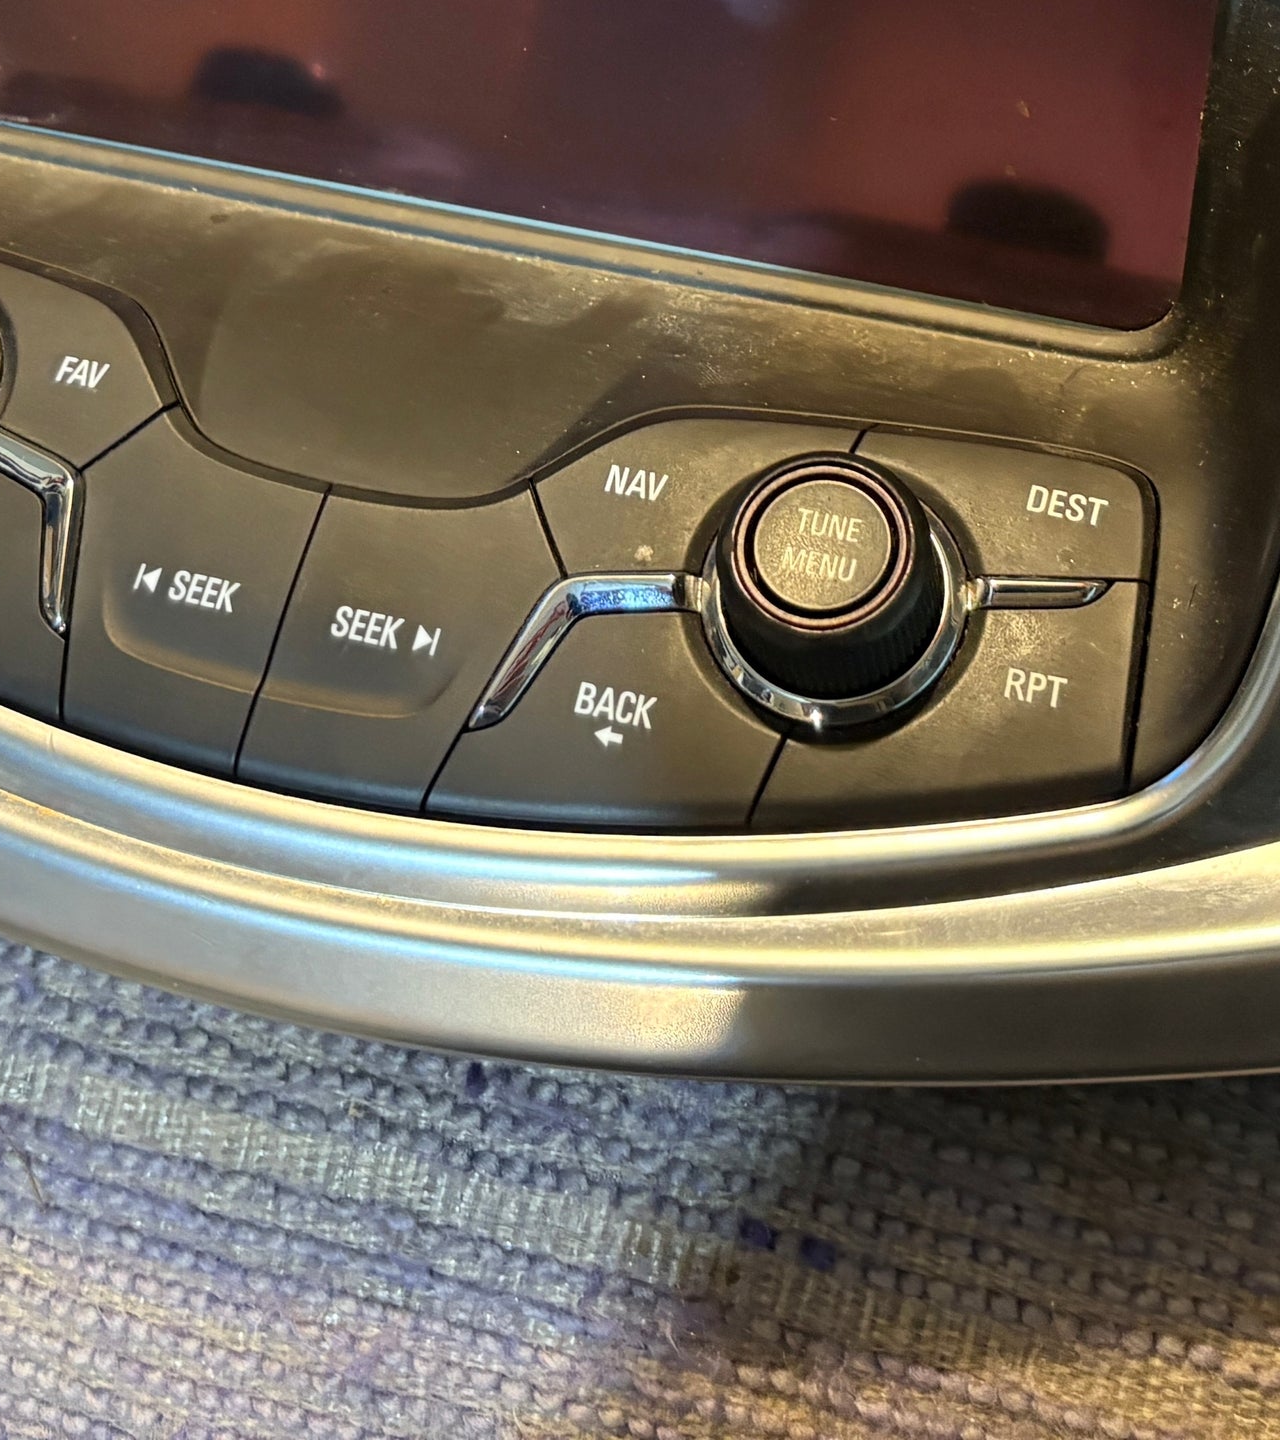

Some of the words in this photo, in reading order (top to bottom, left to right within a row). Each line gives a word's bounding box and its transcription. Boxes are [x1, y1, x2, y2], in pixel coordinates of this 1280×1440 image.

[55, 355, 111, 390] FAV
[604, 464, 669, 502] NAV
[797, 507, 863, 543] TUNE
[1026, 484, 1109, 527] DEST
[781, 544, 858, 582] MENU
[168, 570, 241, 614] SEEK
[330, 605, 406, 650] SEEK
[574, 681, 658, 731] BACK
[1003, 666, 1069, 708] RPT
